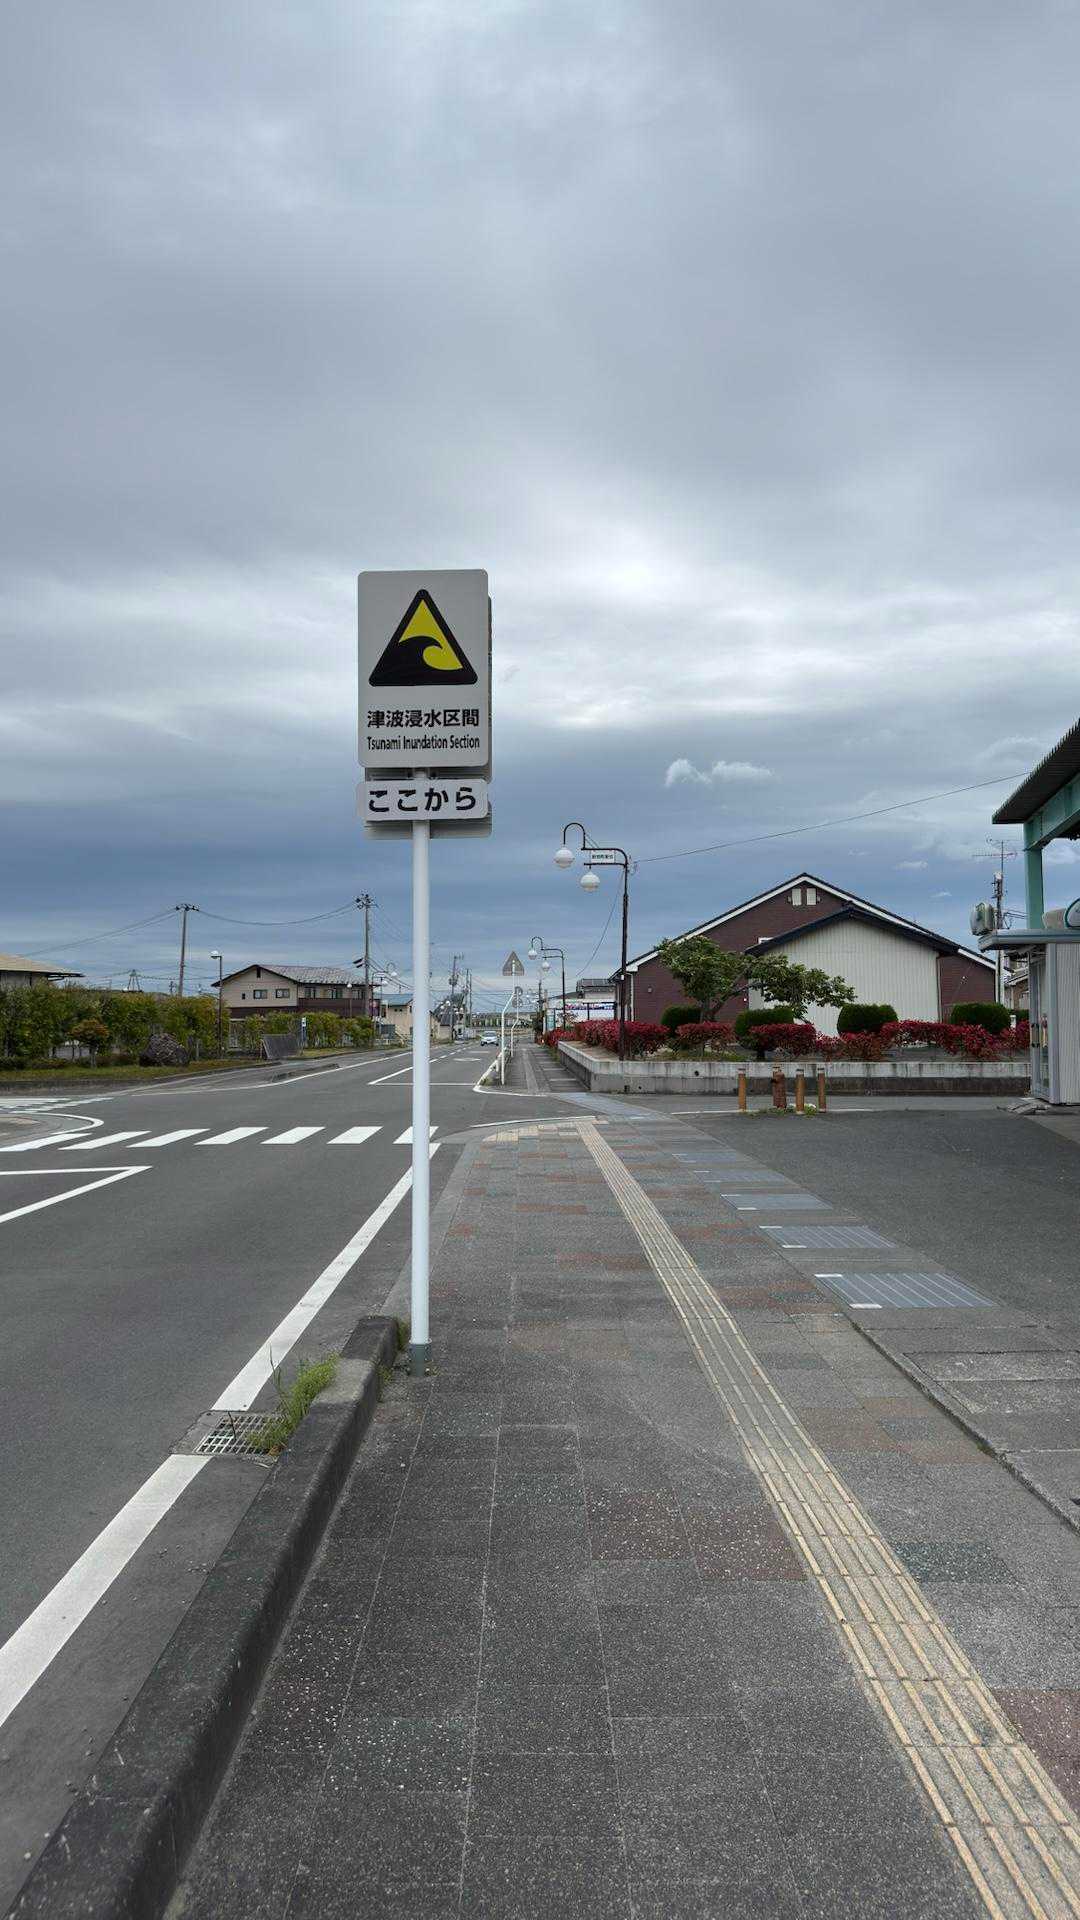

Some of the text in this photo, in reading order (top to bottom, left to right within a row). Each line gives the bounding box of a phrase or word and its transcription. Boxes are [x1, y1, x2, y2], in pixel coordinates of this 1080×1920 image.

[367, 709, 480, 728] 津波浸水区間
[367, 734, 480, 750] Tsunami Inundation Section
[368, 787, 476, 812] ここから
